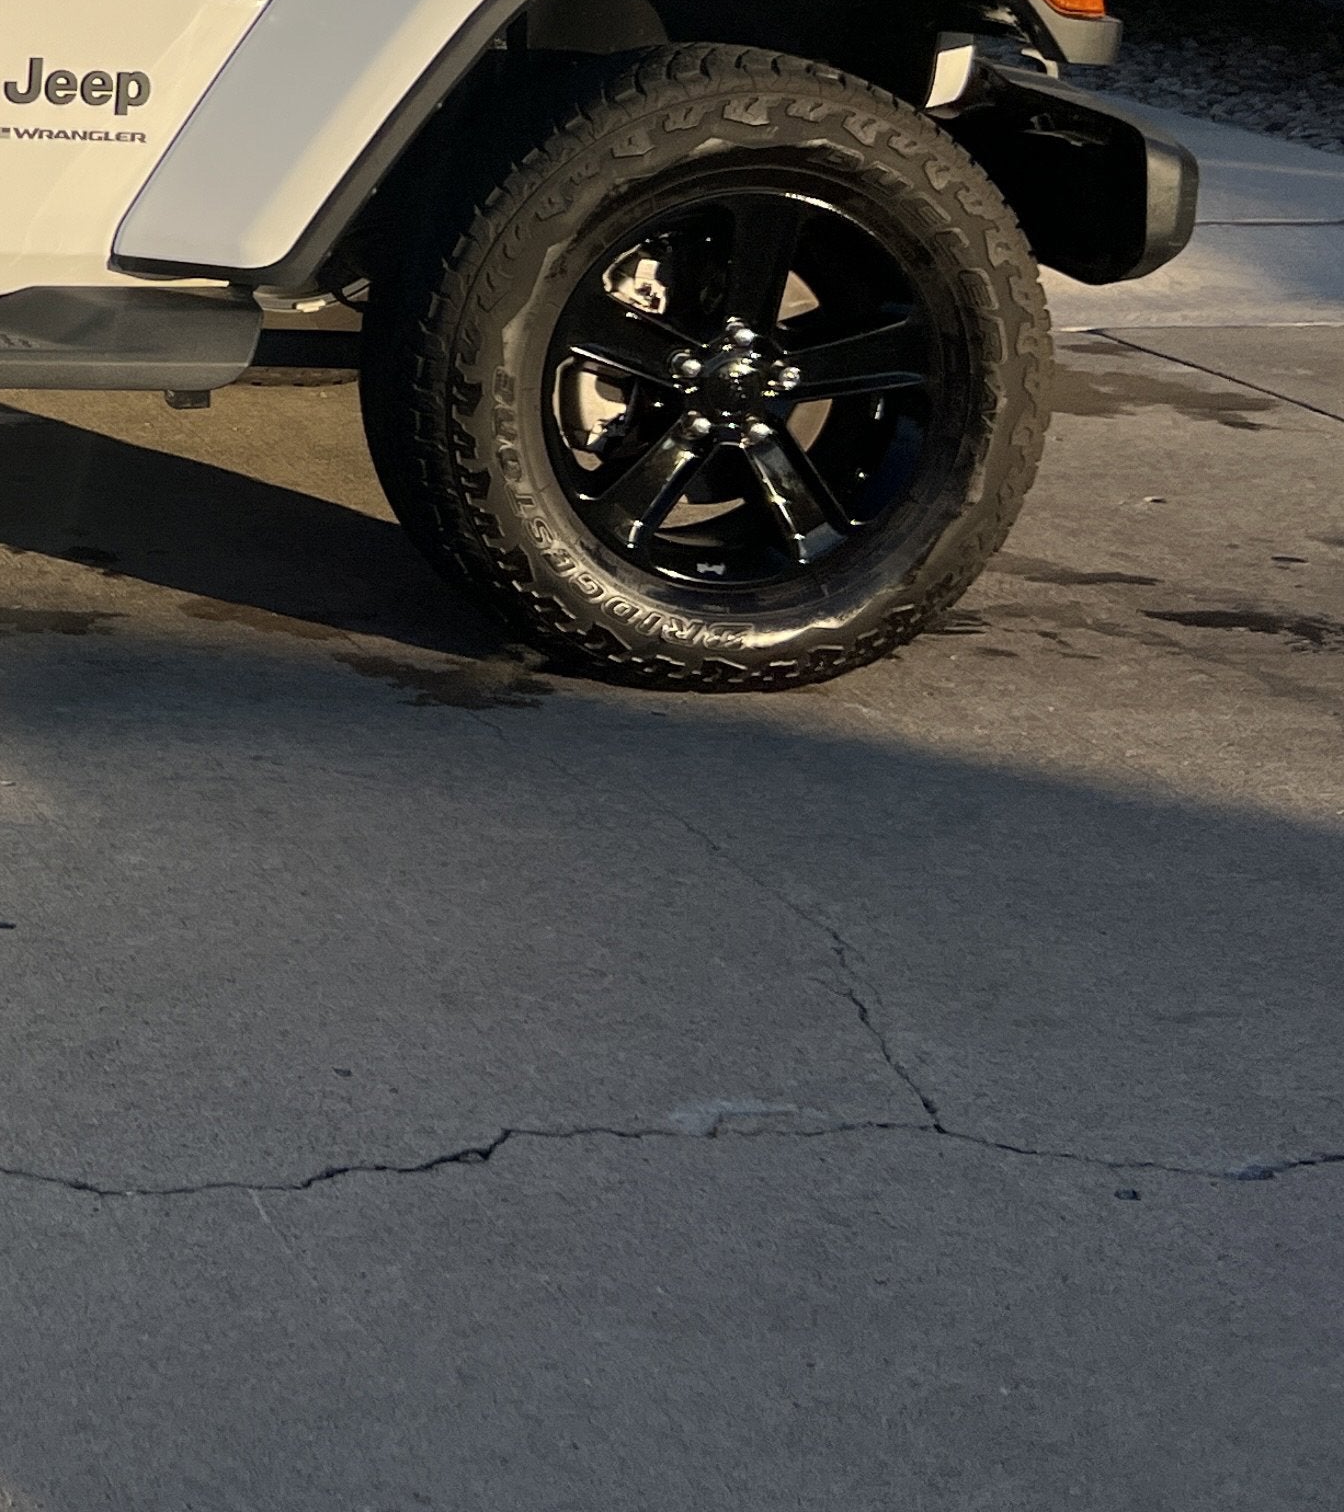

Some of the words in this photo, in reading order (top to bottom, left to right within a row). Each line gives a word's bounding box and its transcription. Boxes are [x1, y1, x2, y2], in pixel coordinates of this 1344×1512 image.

[3, 57, 151, 116] Jeep
[12, 127, 147, 143] WRANGLER
[492, 367, 754, 651] BRIDGESTONE
